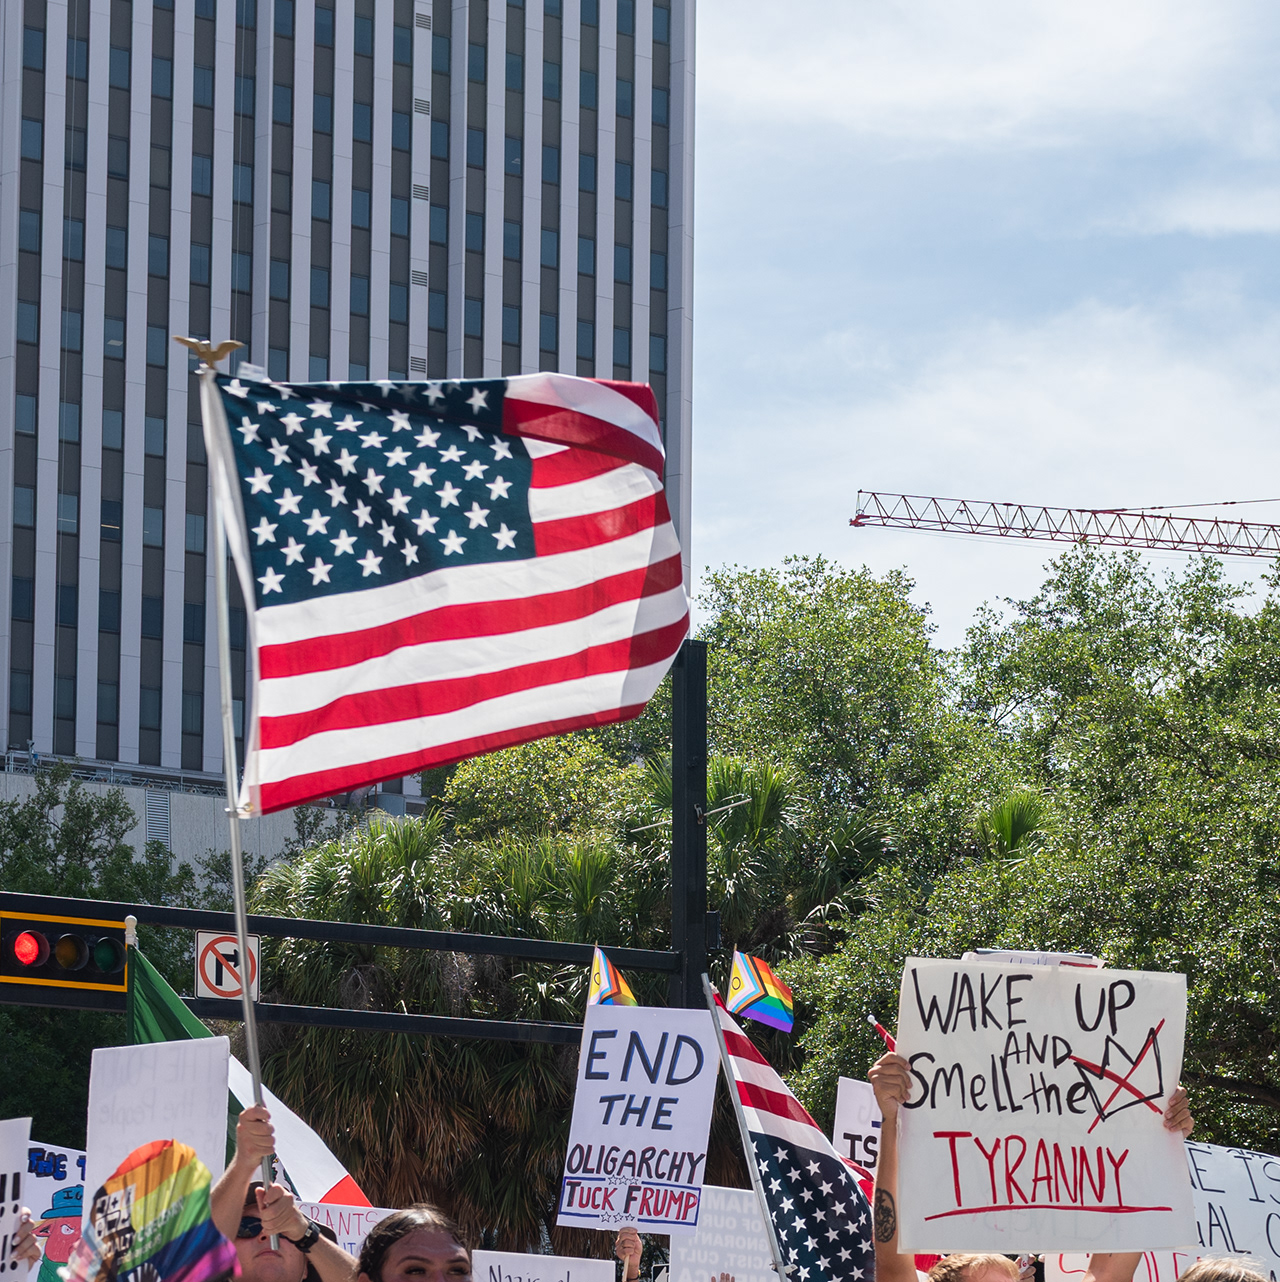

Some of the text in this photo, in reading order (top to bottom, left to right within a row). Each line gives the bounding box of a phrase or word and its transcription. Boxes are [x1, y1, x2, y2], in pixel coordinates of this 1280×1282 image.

[912, 968, 1136, 1035] WAKE UP
[585, 1029, 705, 1086] END
[1004, 1031, 1071, 1068] AND
[599, 1094, 679, 1130] THE
[566, 1143, 705, 1185] OLIGARCHY
[933, 1130, 1130, 1207] TYRANNY
[566, 1181, 699, 1221] TUCK FRUMP
